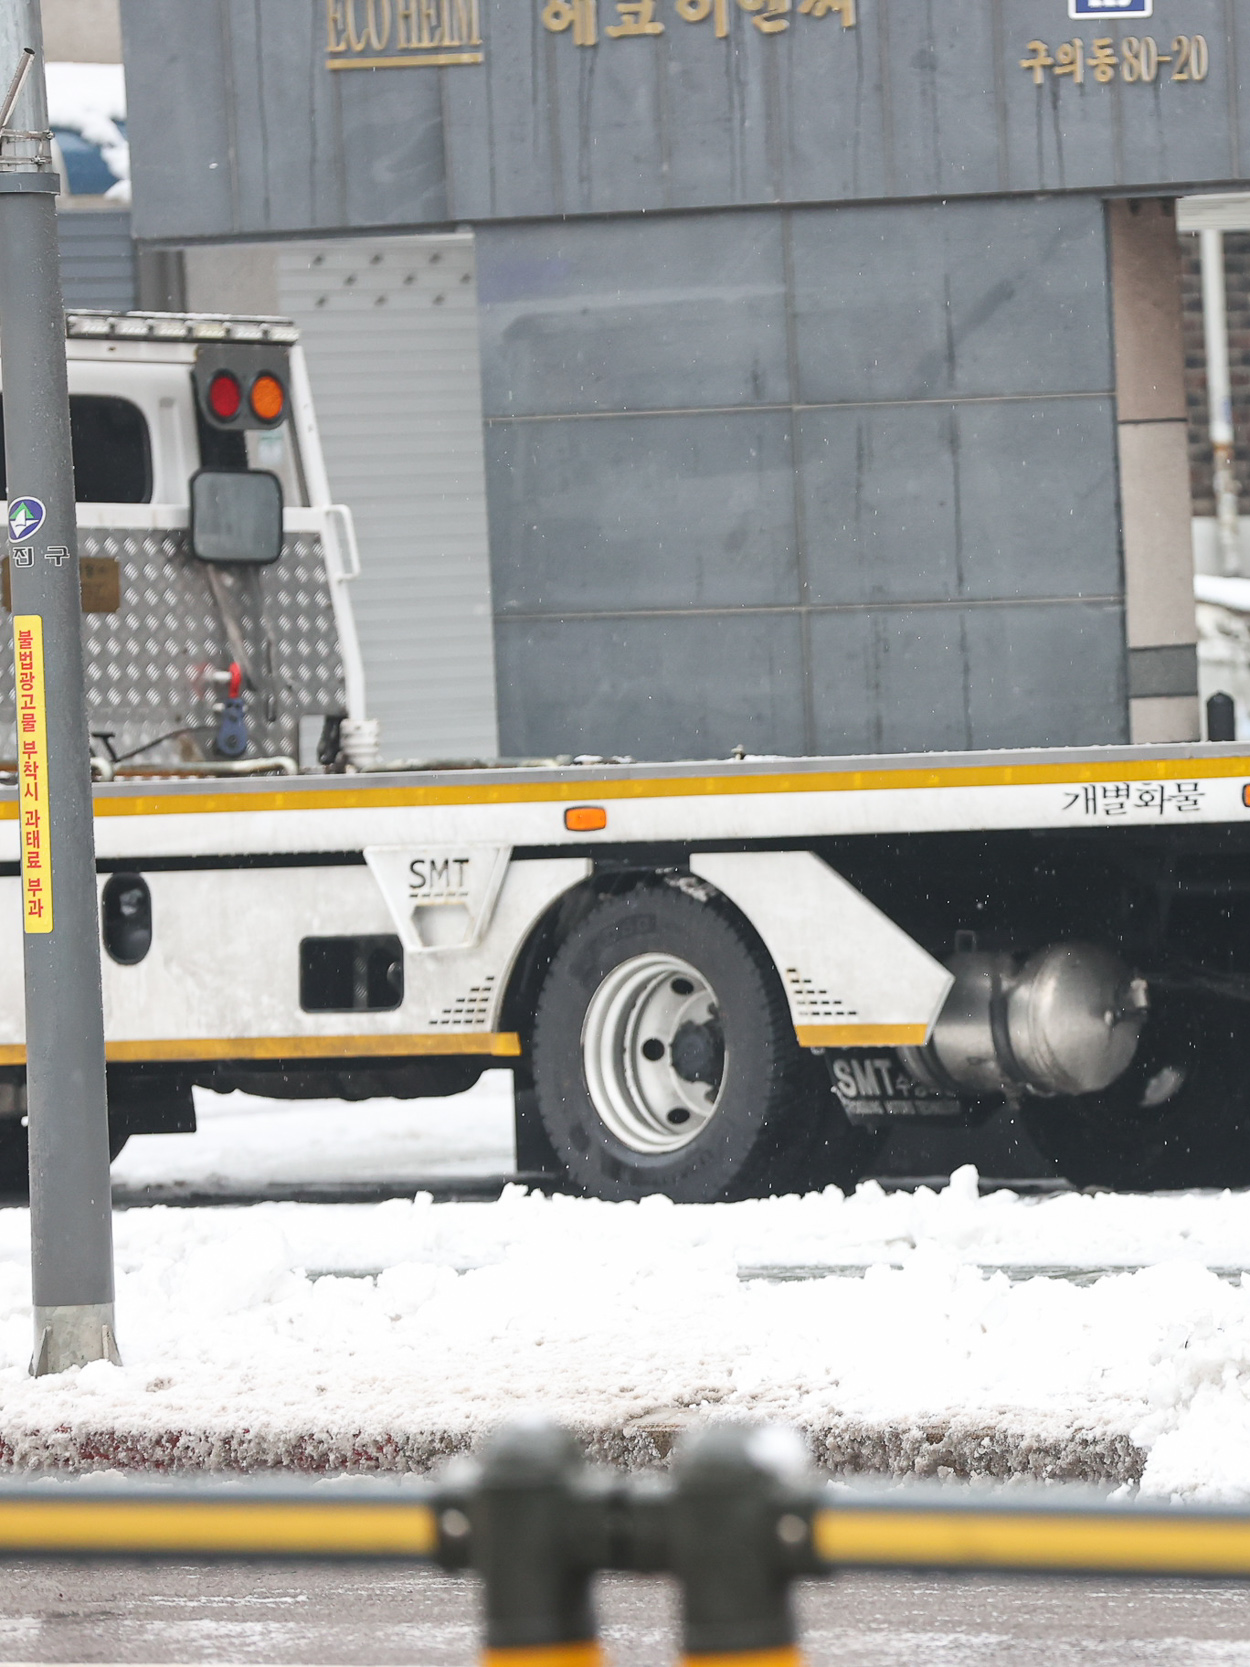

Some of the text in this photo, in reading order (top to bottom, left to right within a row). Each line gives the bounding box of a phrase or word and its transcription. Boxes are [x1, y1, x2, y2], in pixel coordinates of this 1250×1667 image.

[325, 0, 484, 53] ECO HEIM
[18, 629, 45, 919] 불법광고물 부착시 과태료 부과
[1061, 781, 1206, 816] 개별화물
[408, 857, 471, 889] SMT
[832, 1058, 895, 1099] SMT
